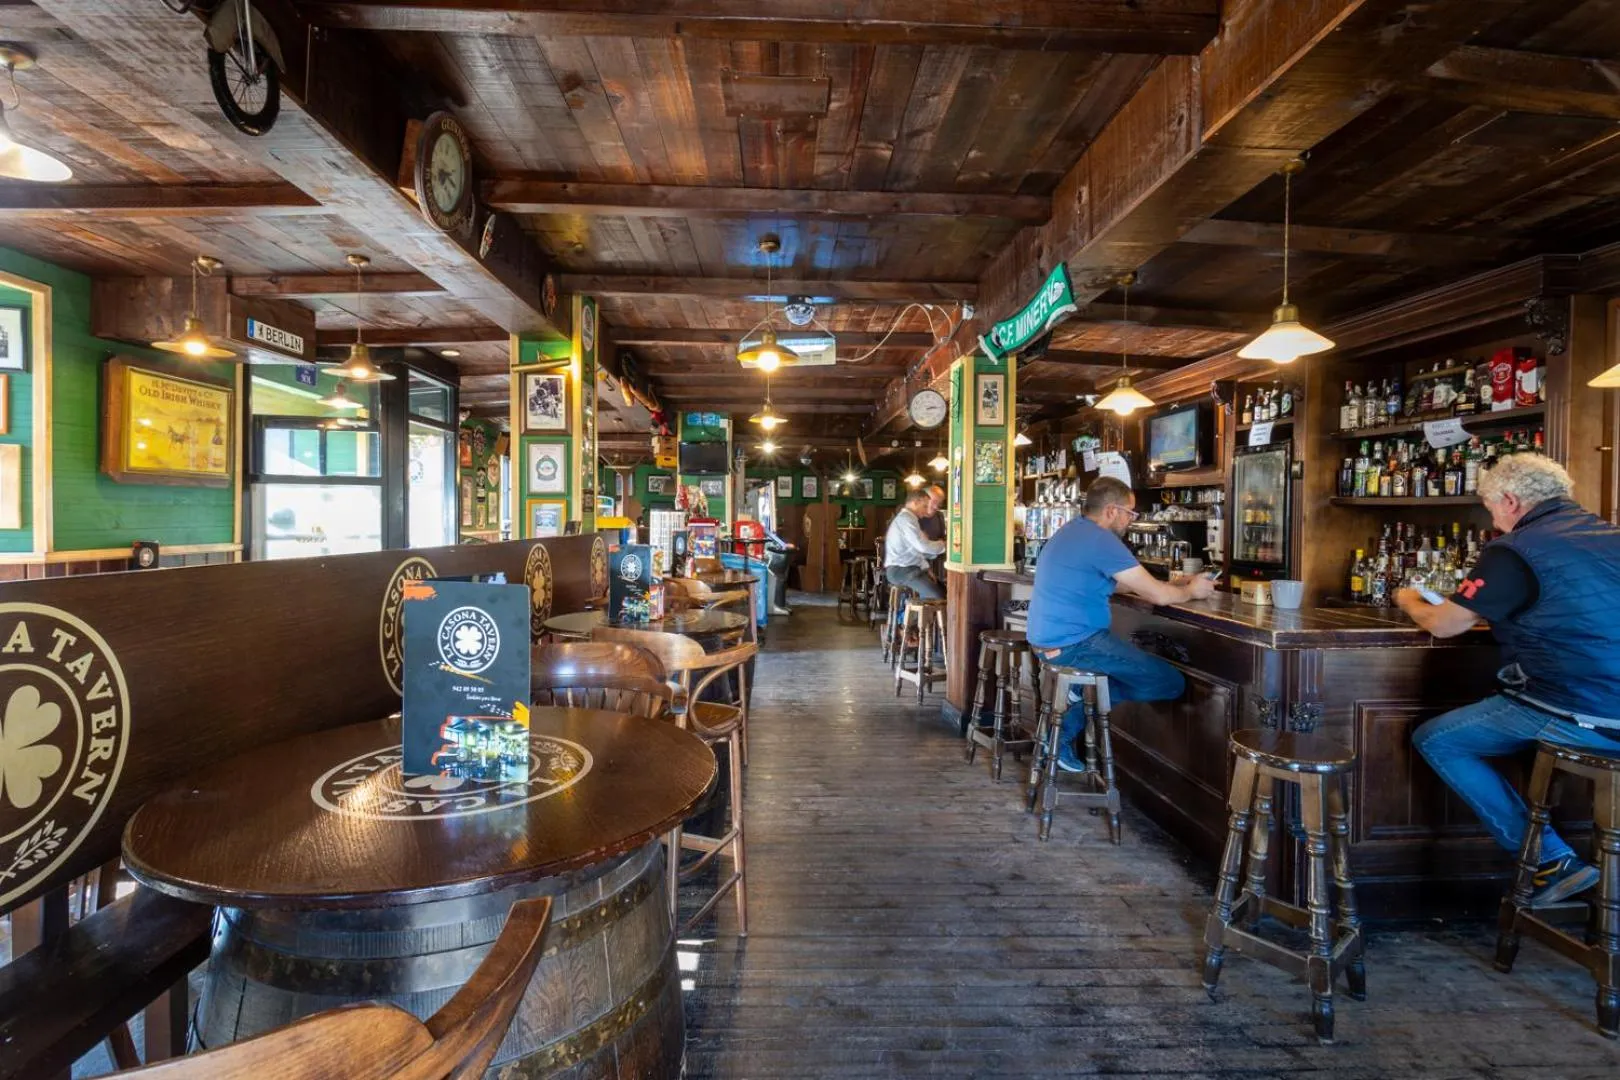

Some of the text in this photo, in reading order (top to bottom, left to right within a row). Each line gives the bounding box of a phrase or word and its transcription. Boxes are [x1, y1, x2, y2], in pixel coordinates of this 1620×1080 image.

[266, 327, 301, 350] BERLIN
[139, 384, 160, 399] OLD
[161, 391, 188, 404] IRISH
[441, 611, 497, 661] LA CASONA TAVERN
[46, 627, 117, 805] TAVERN
